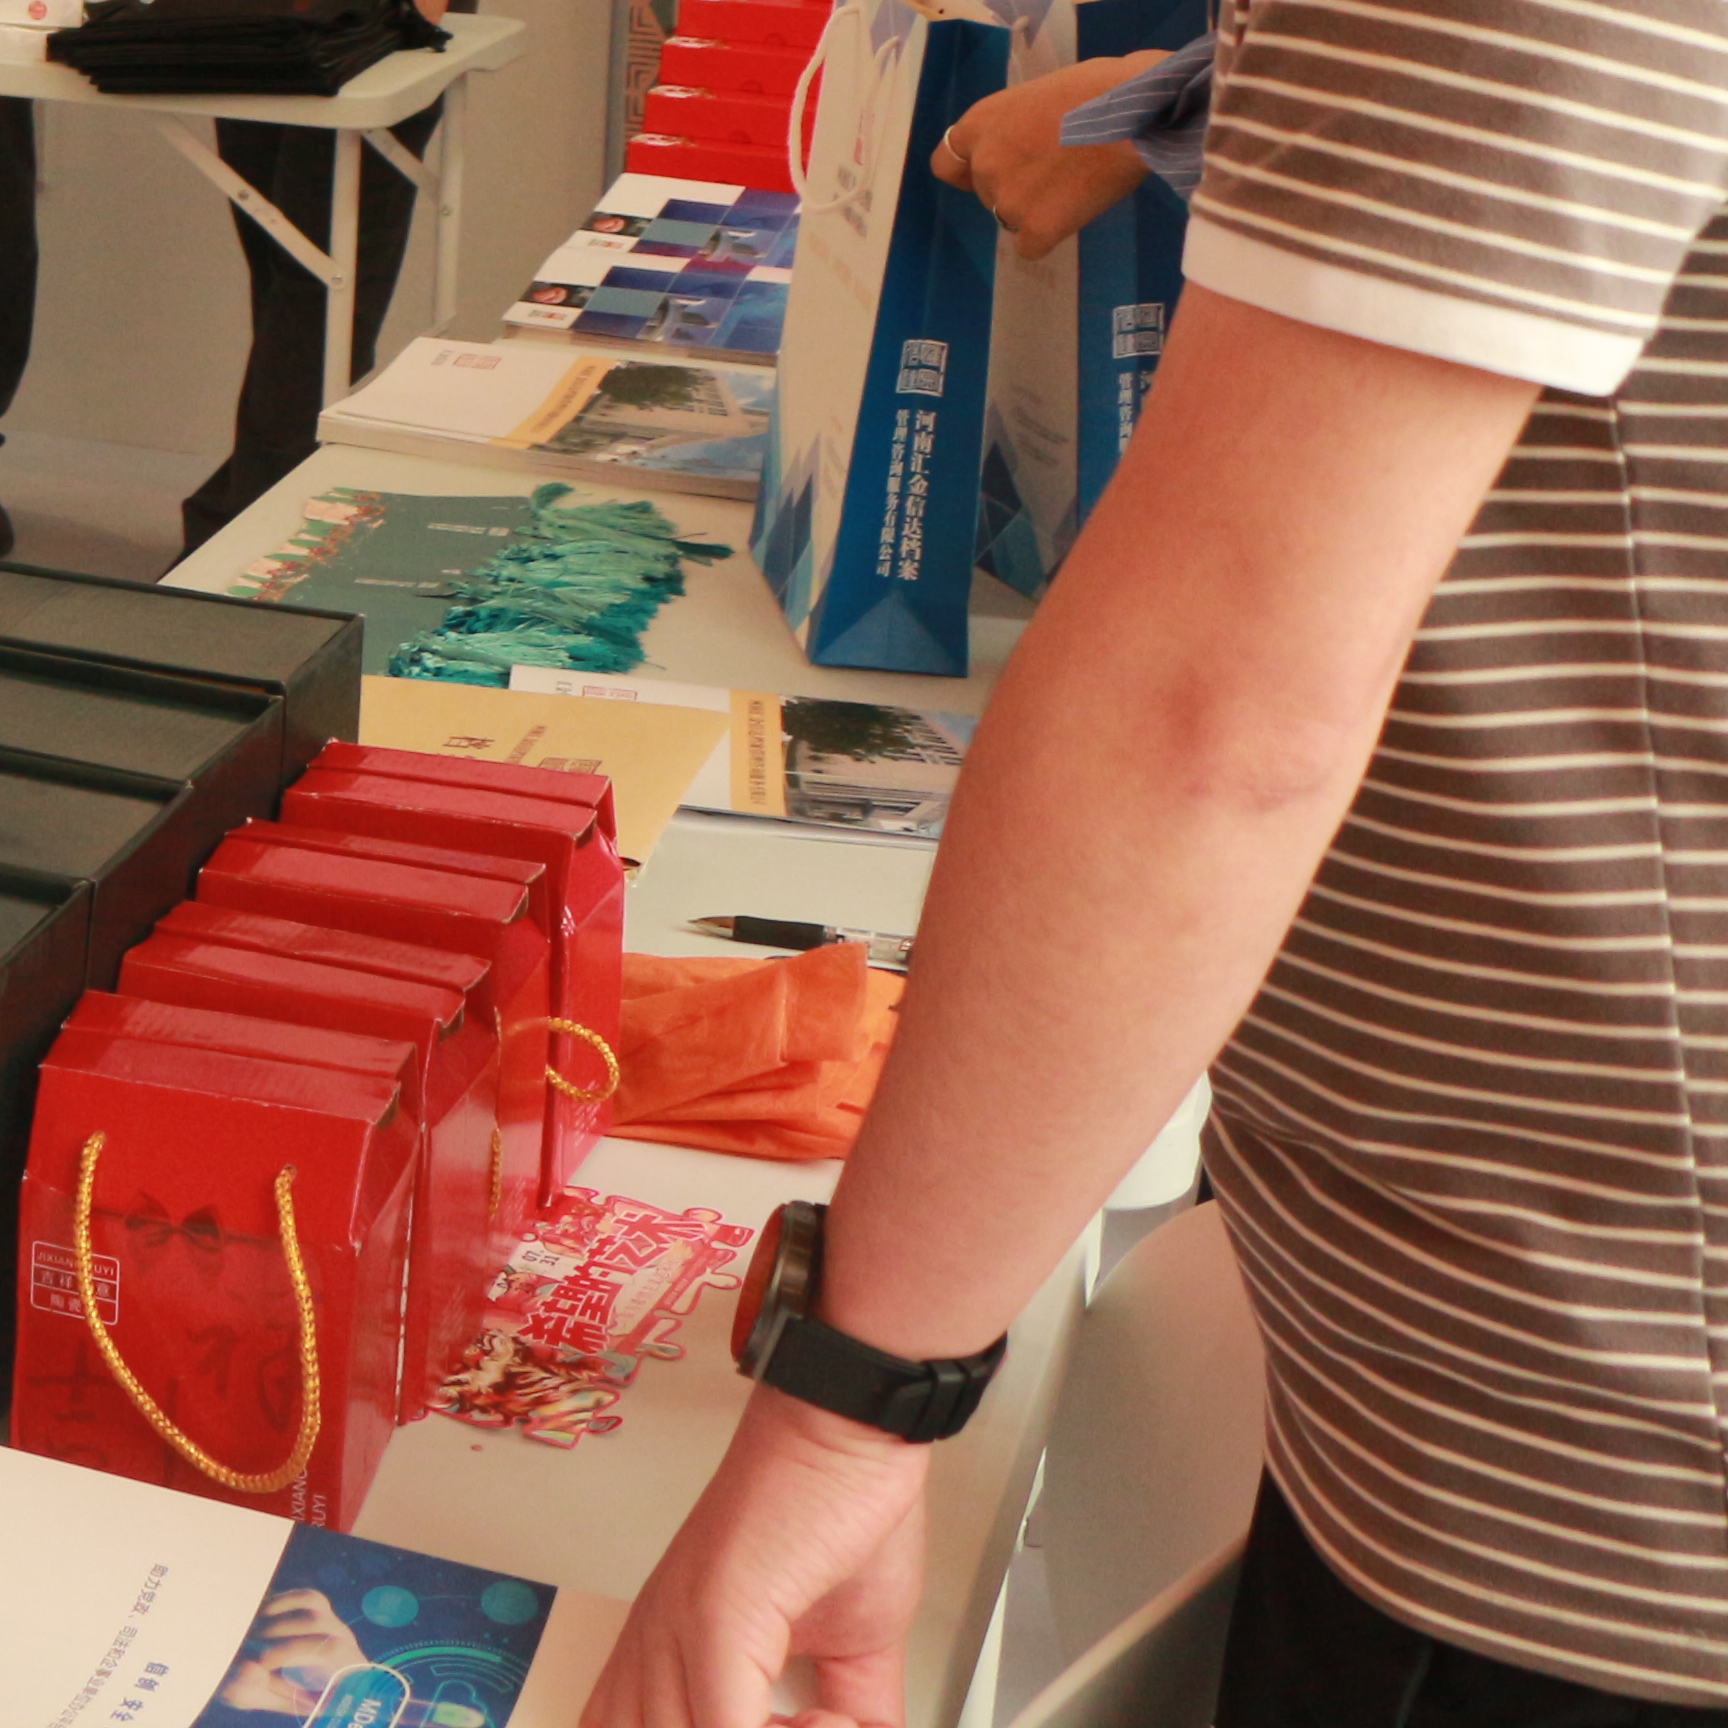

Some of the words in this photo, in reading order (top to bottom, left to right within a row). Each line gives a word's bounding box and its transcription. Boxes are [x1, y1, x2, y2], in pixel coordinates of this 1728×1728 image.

[897, 408, 938, 581] 河南汇金信达档案
